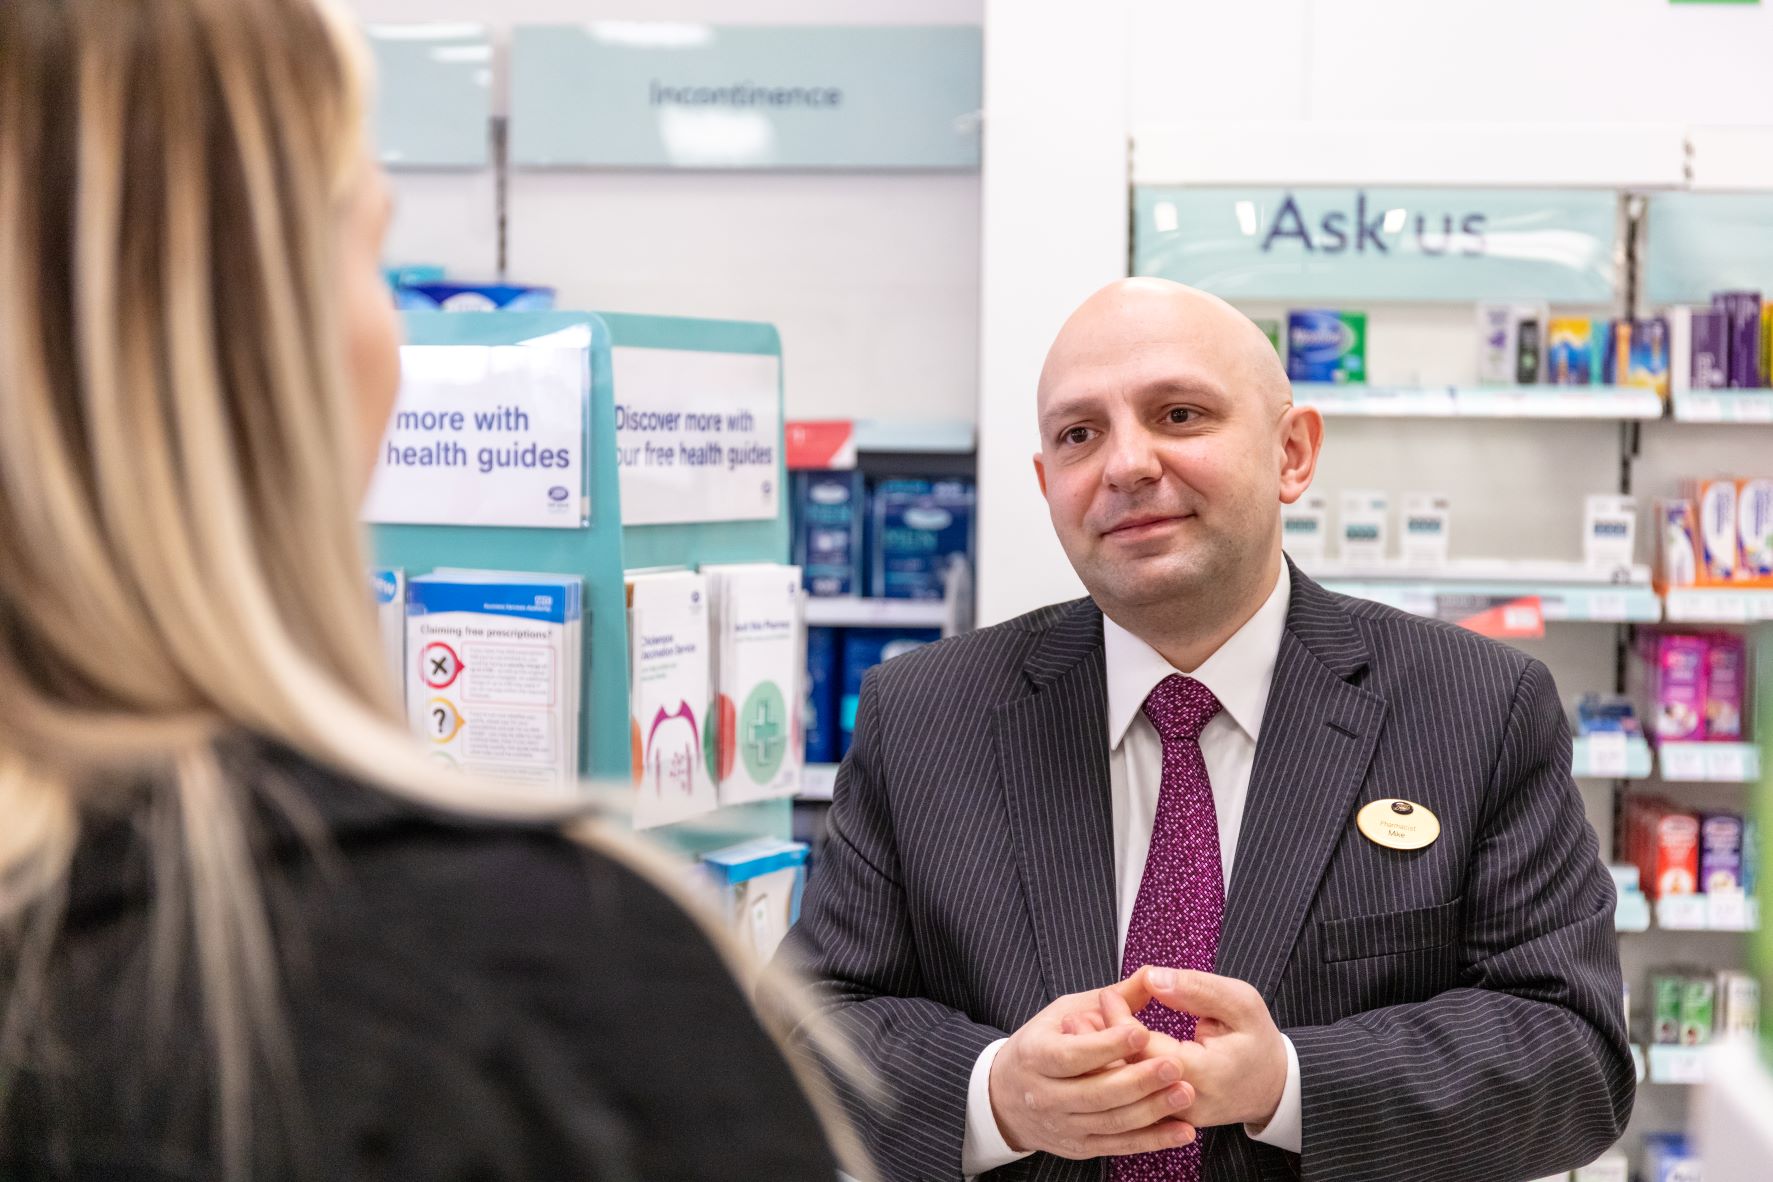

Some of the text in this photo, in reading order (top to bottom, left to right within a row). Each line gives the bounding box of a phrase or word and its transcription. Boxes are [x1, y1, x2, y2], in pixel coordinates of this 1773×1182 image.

[649, 78, 842, 108] Incontinence
[1261, 191, 1488, 257] Ask us
[397, 405, 530, 432] more with
[615, 404, 754, 432] Discover more with
[386, 440, 570, 474] health guides
[616, 441, 772, 471] our free health guides
[420, 624, 462, 637] Claiming
[465, 625, 483, 636] free
[1388, 829, 1406, 838] Mike
